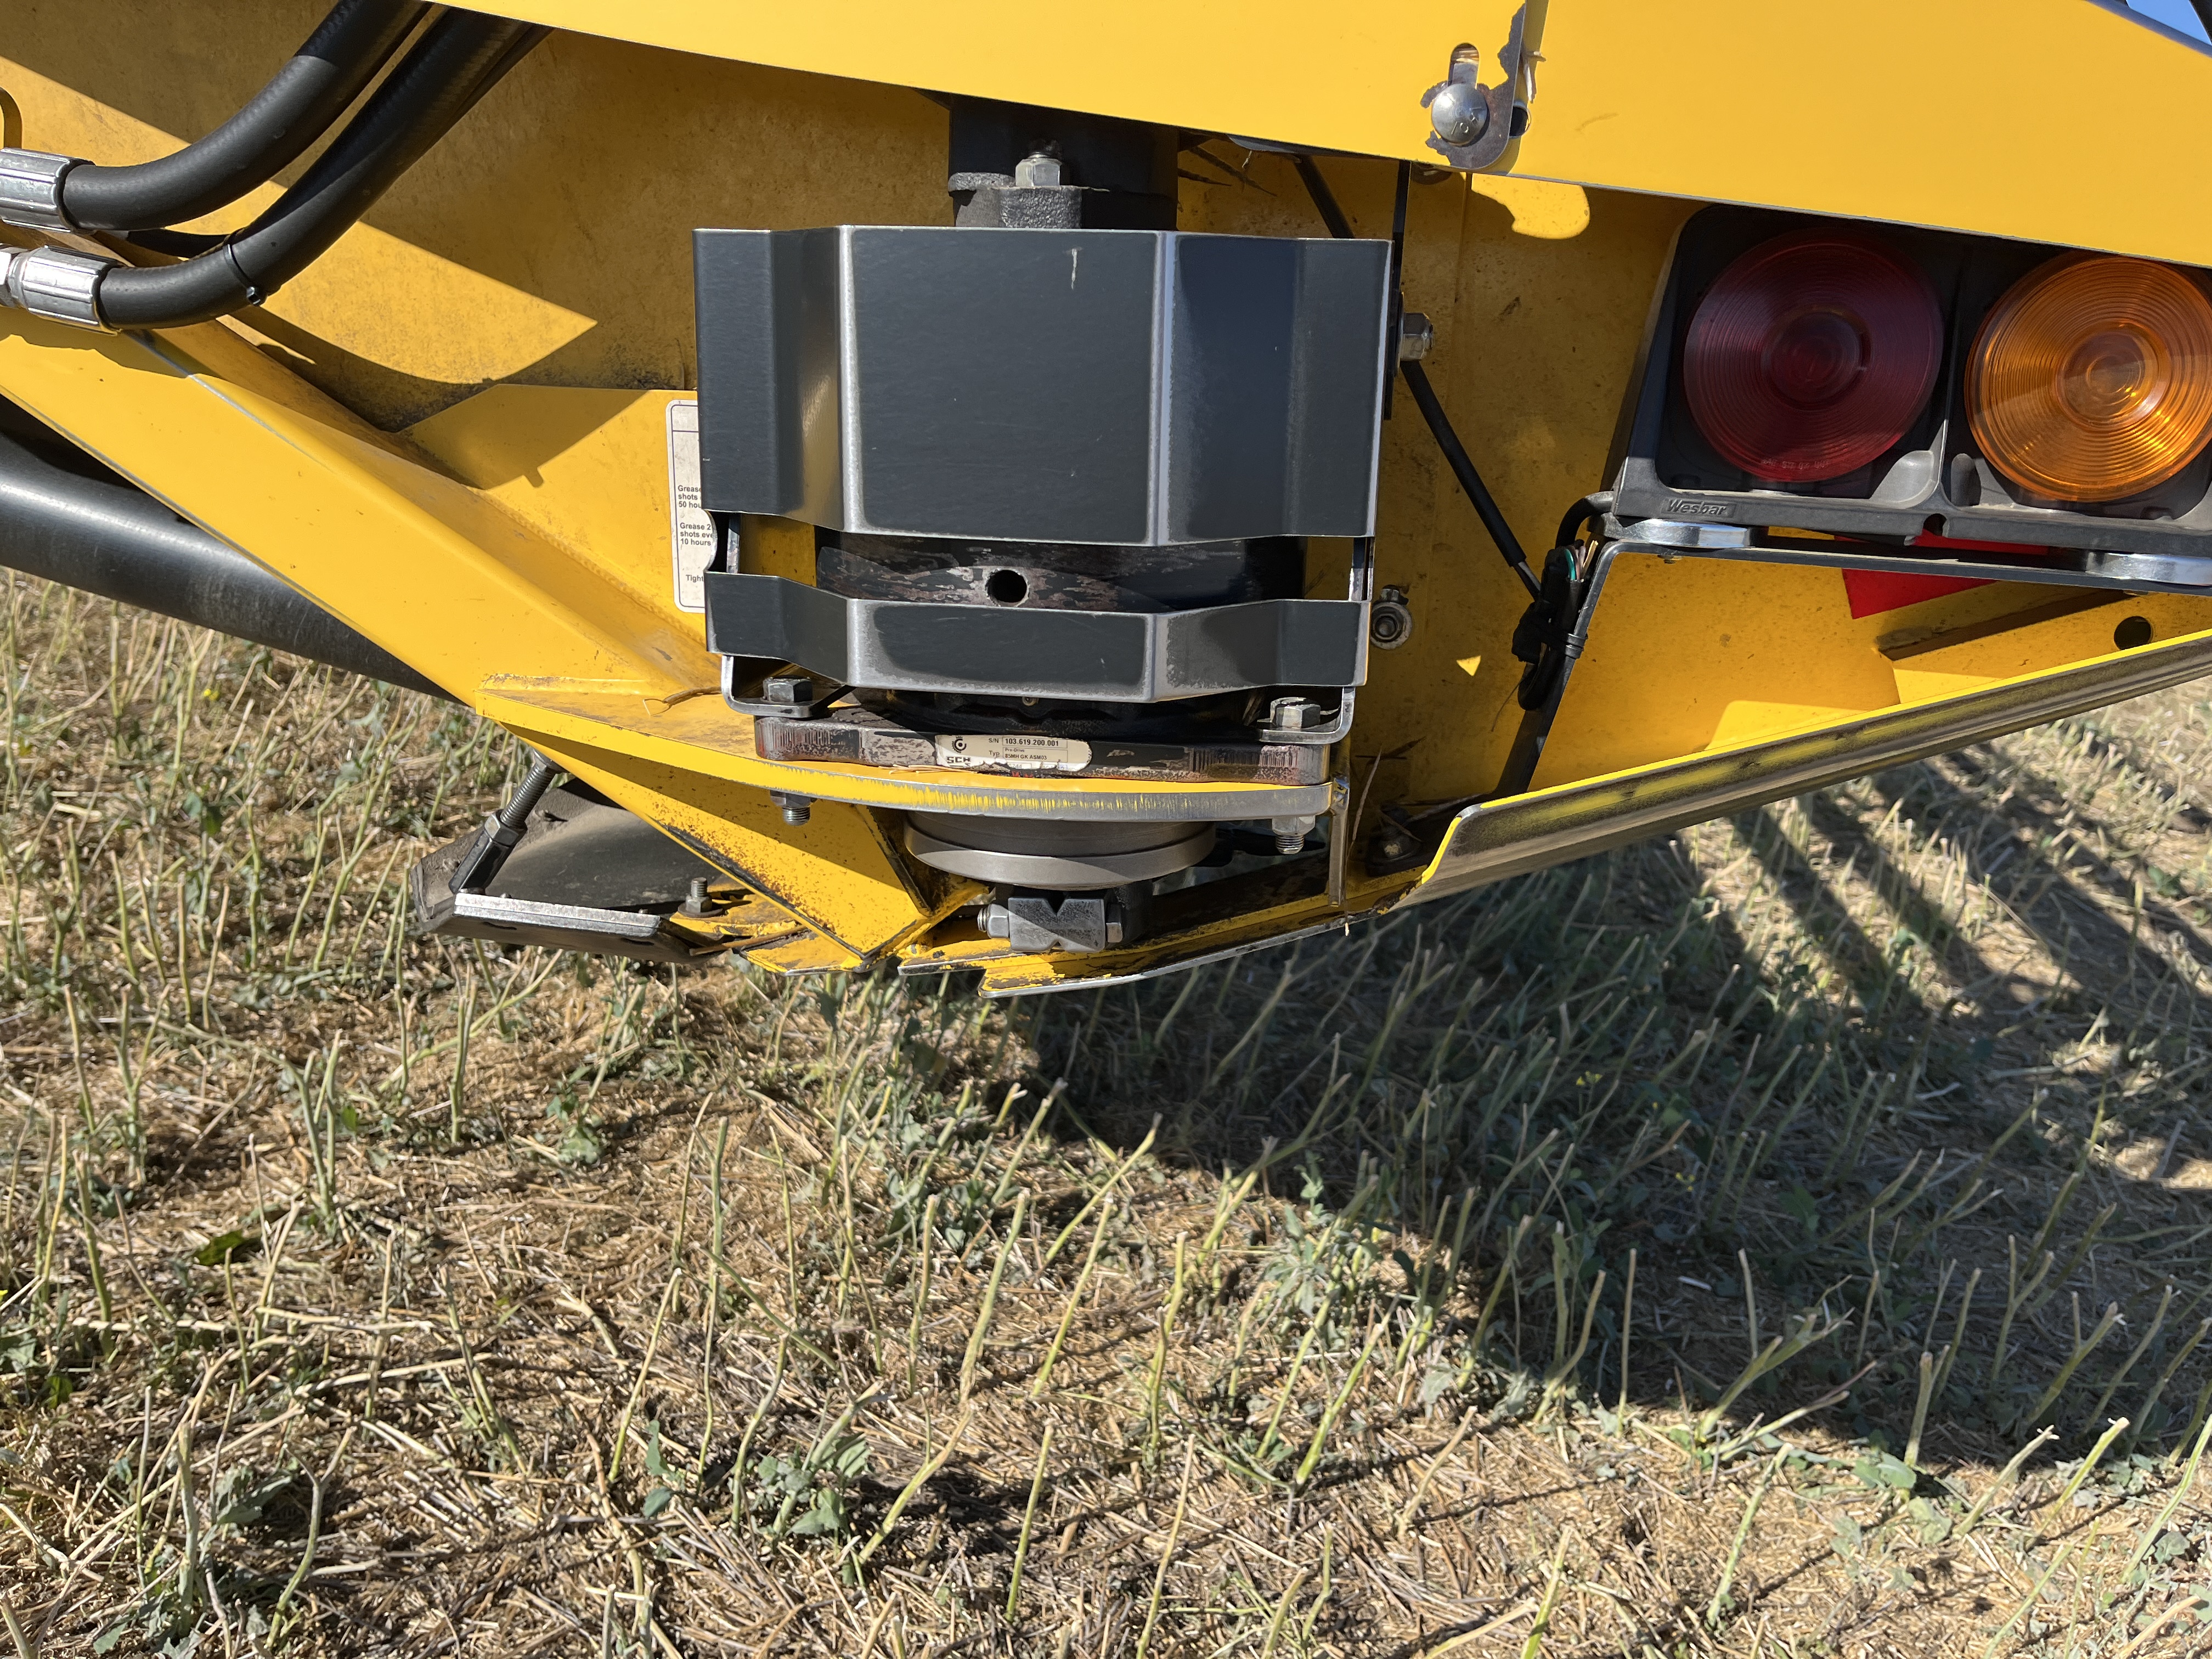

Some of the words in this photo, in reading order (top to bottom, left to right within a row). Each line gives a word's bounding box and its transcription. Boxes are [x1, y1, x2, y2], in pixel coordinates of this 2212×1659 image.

[1668, 499, 1726, 515] Wesbar
[686, 574, 704, 583] Tight
[1005, 738, 1059, 747] 103.619.200.001
